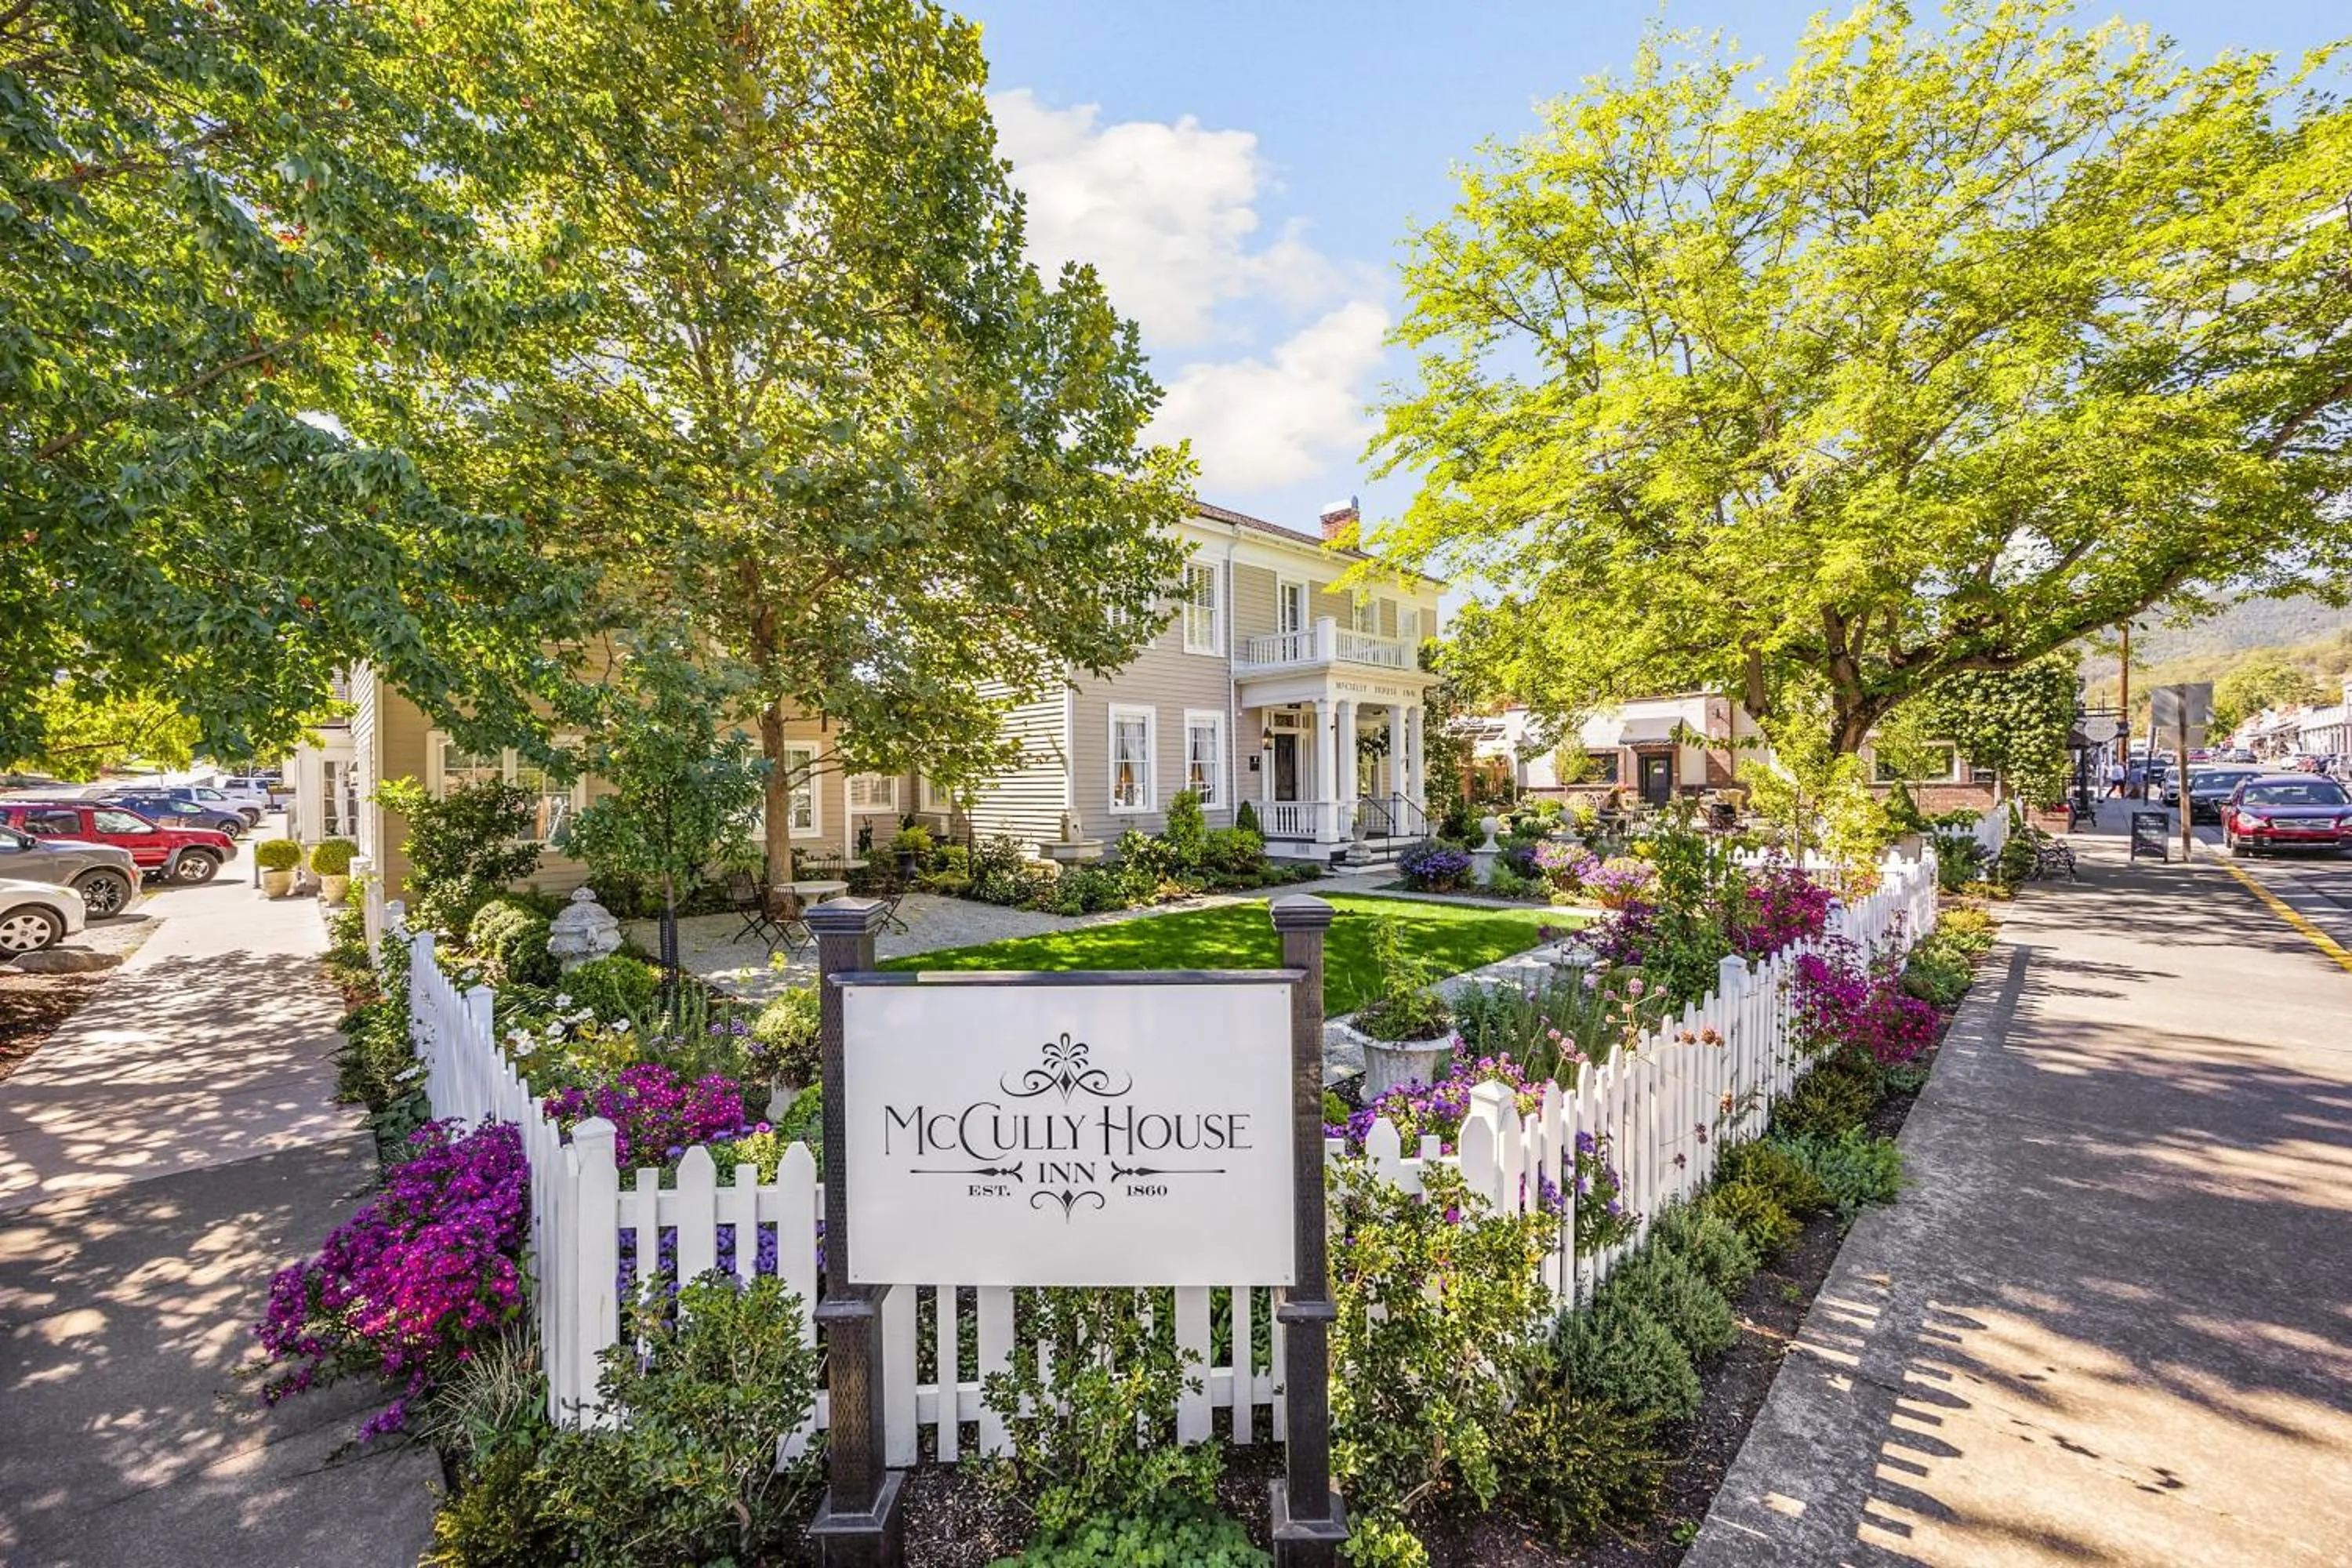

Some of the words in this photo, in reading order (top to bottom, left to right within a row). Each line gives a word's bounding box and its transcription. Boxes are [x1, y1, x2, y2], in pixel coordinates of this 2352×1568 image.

[1096, 1105, 1253, 1156] HOUSE
[1039, 1162, 1096, 1184] INN
[968, 1185, 1011, 1196] EST.
[1127, 1185, 1168, 1196] 1860
